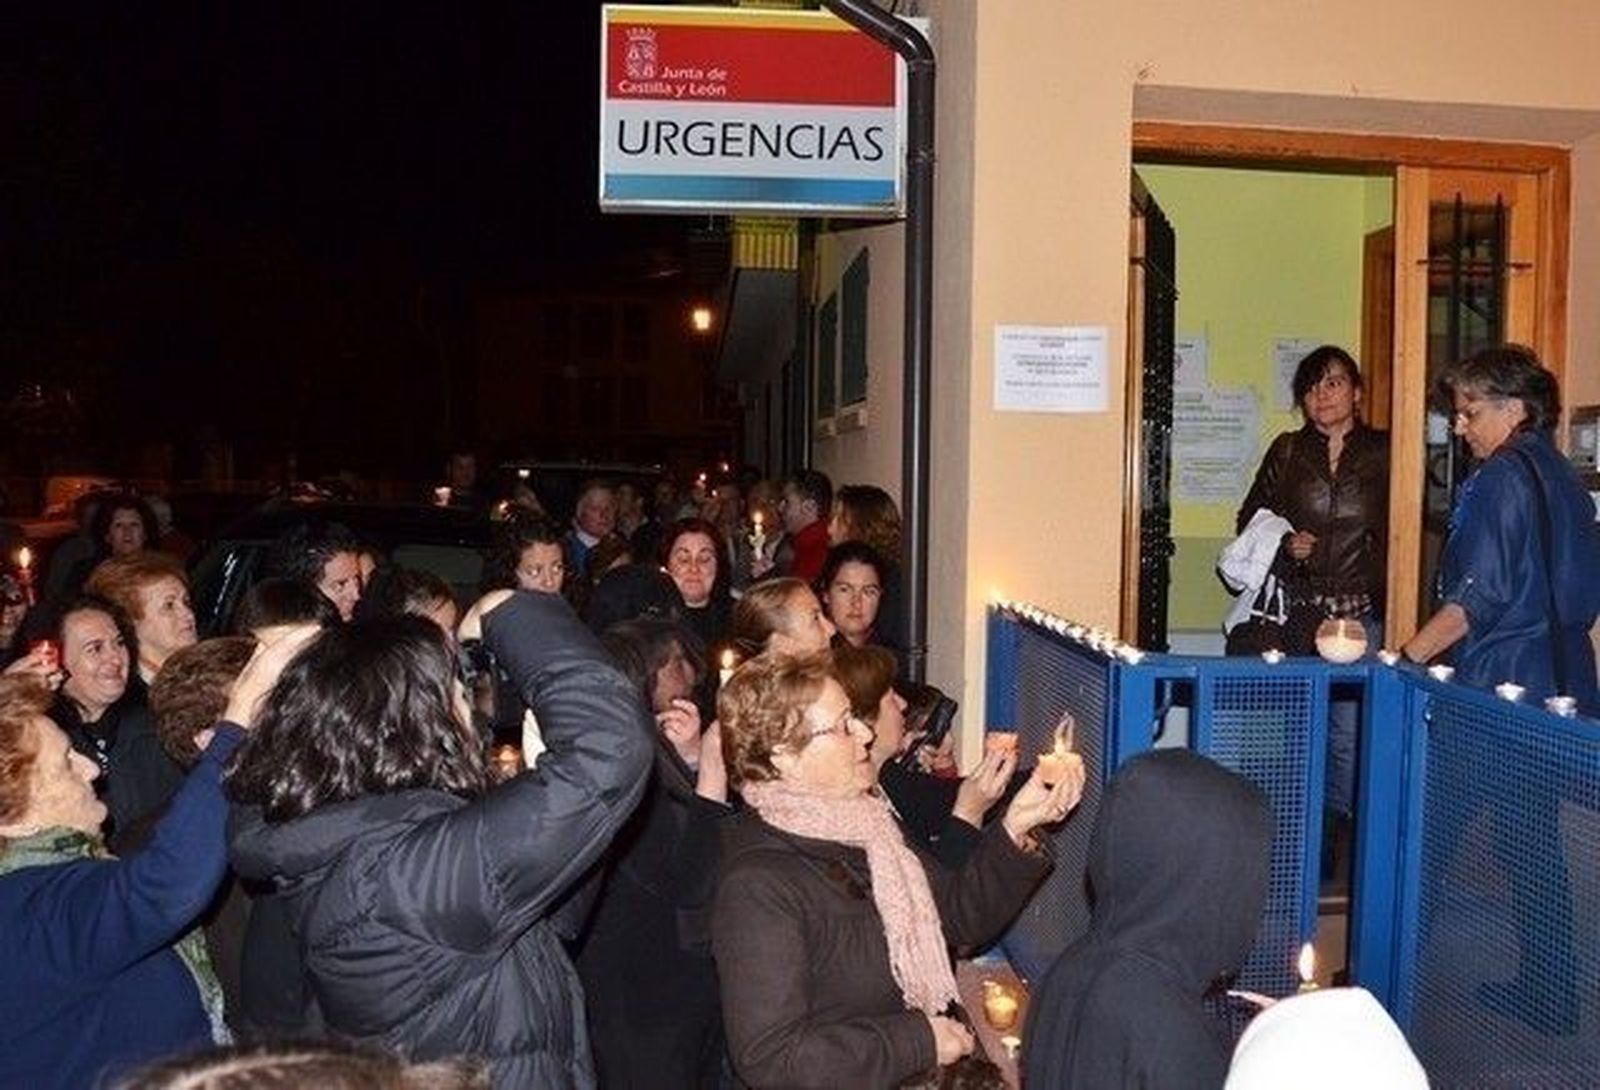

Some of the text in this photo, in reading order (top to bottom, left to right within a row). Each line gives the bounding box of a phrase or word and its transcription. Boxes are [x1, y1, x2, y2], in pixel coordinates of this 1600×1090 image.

[661, 66, 727, 81] Junta de
[618, 80, 727, 98] Castilla y León
[618, 119, 884, 162] URGENCIAS
